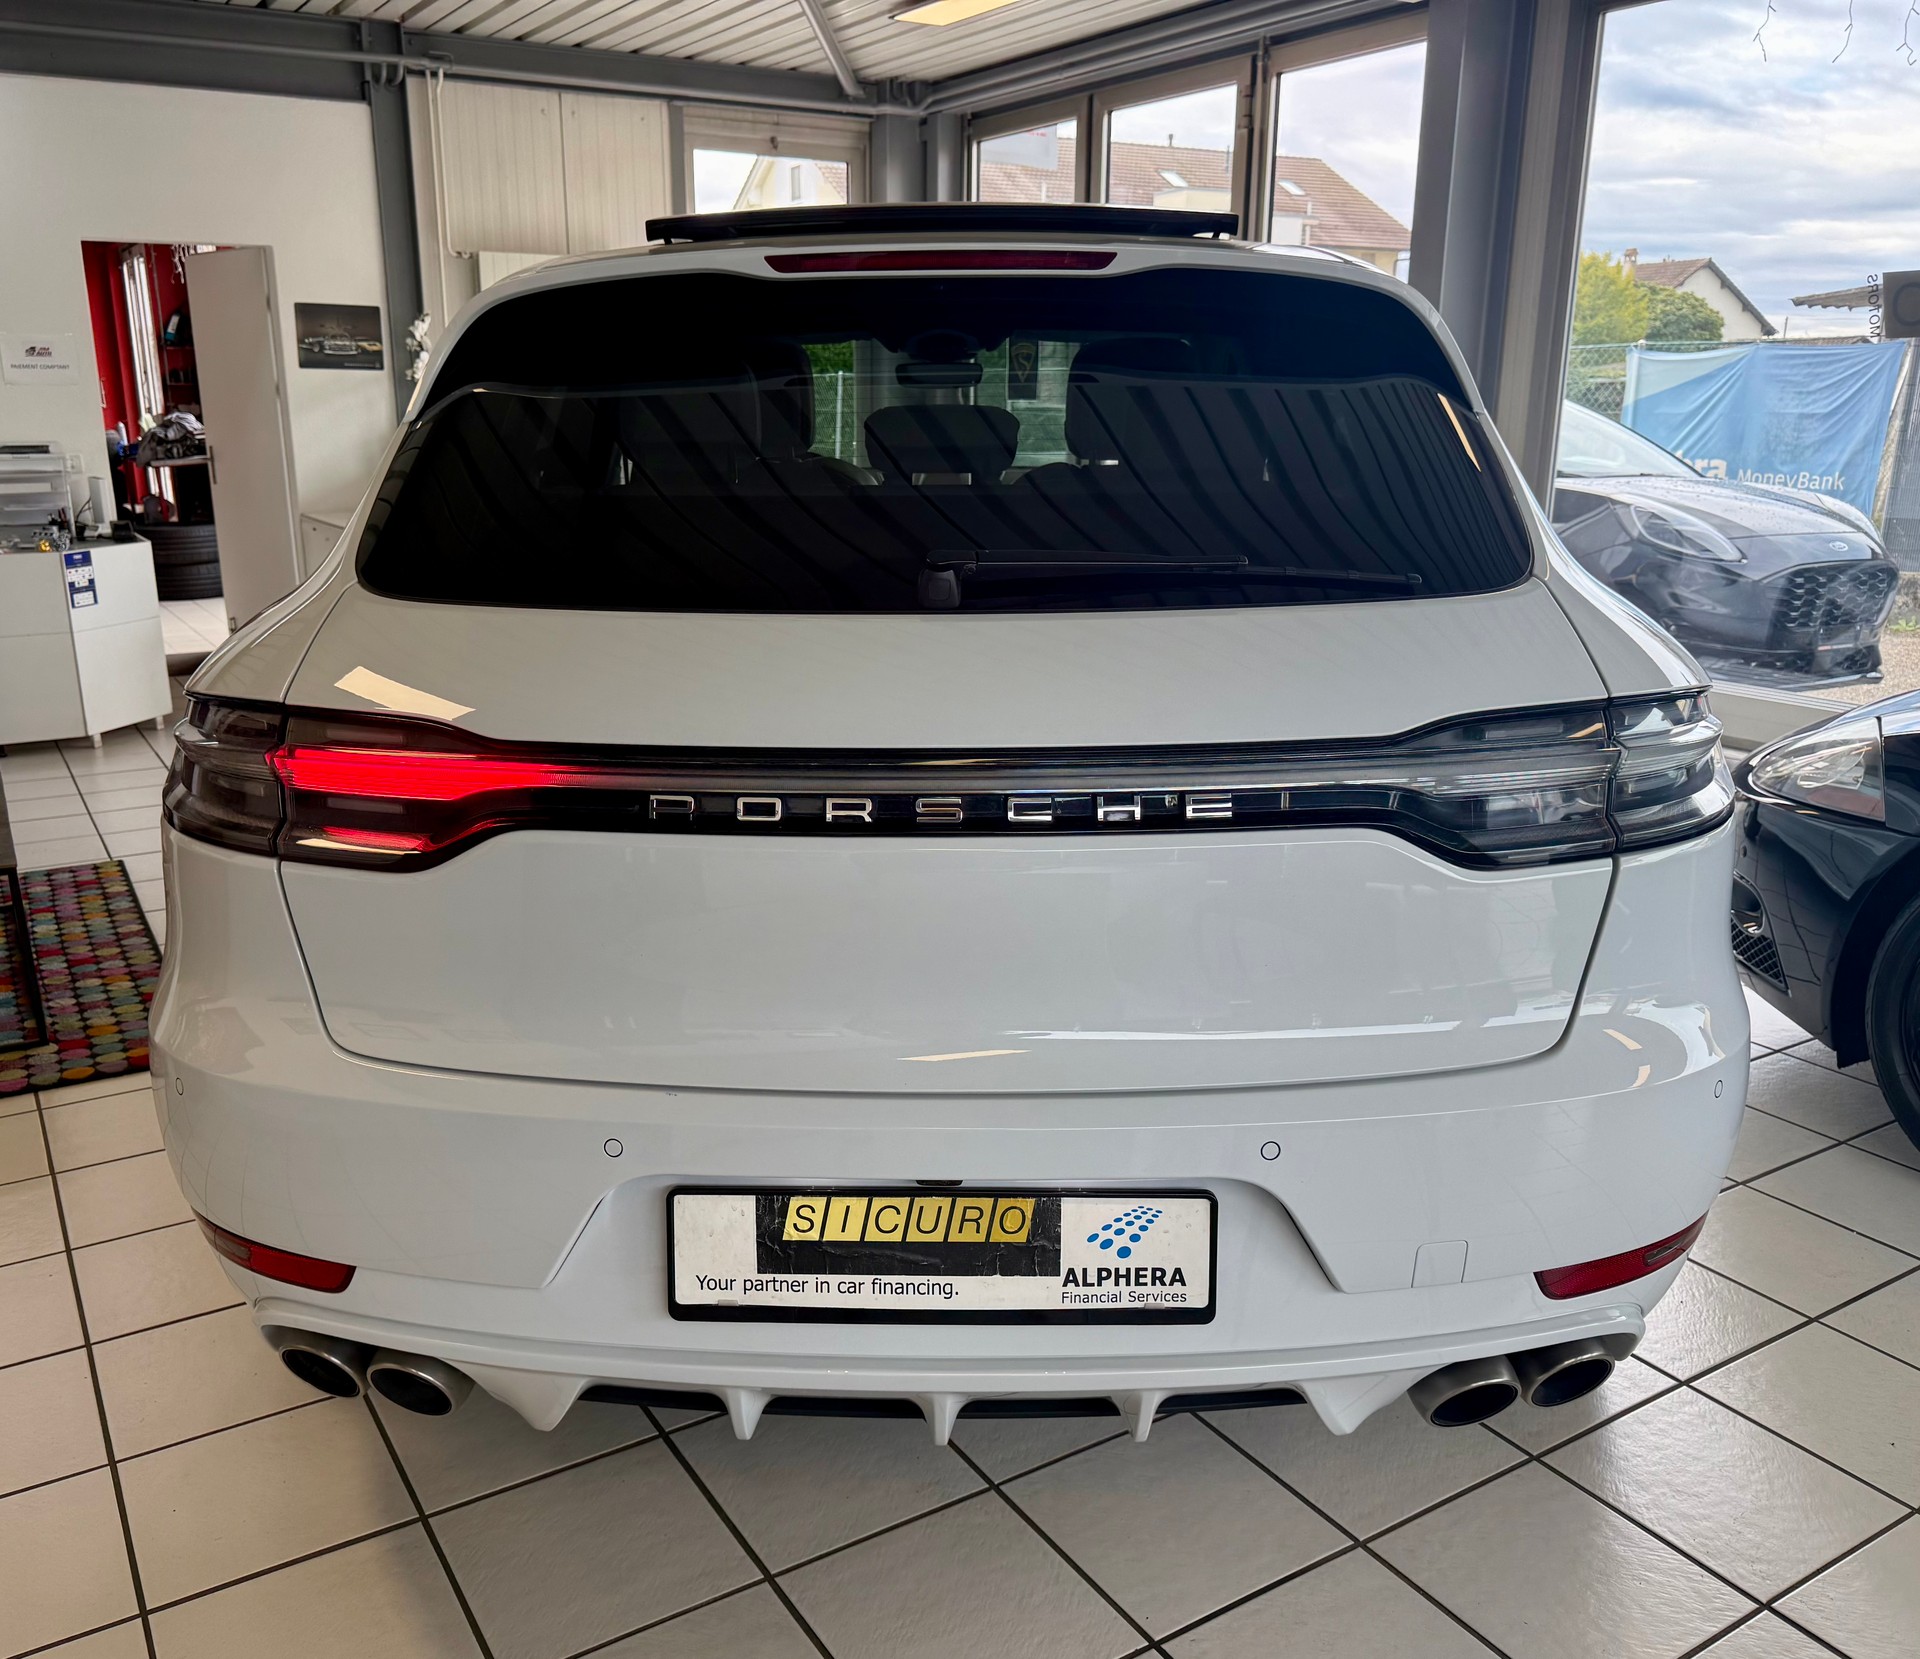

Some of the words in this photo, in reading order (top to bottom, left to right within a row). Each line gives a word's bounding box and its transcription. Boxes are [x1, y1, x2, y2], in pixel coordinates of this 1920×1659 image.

[1736, 468, 1846, 491] MoneyBank
[650, 794, 1232, 822] PORSCHE
[793, 1204, 1026, 1235] SICURO
[696, 1275, 736, 1291] Your
[743, 1277, 808, 1294] partner
[815, 1277, 830, 1293] in
[837, 1280, 865, 1294] car
[871, 1278, 959, 1299] financing.
[1062, 1267, 1187, 1287] ALPHERA
[1061, 1291, 1122, 1304] Financial
[1128, 1290, 1187, 1303] Services
